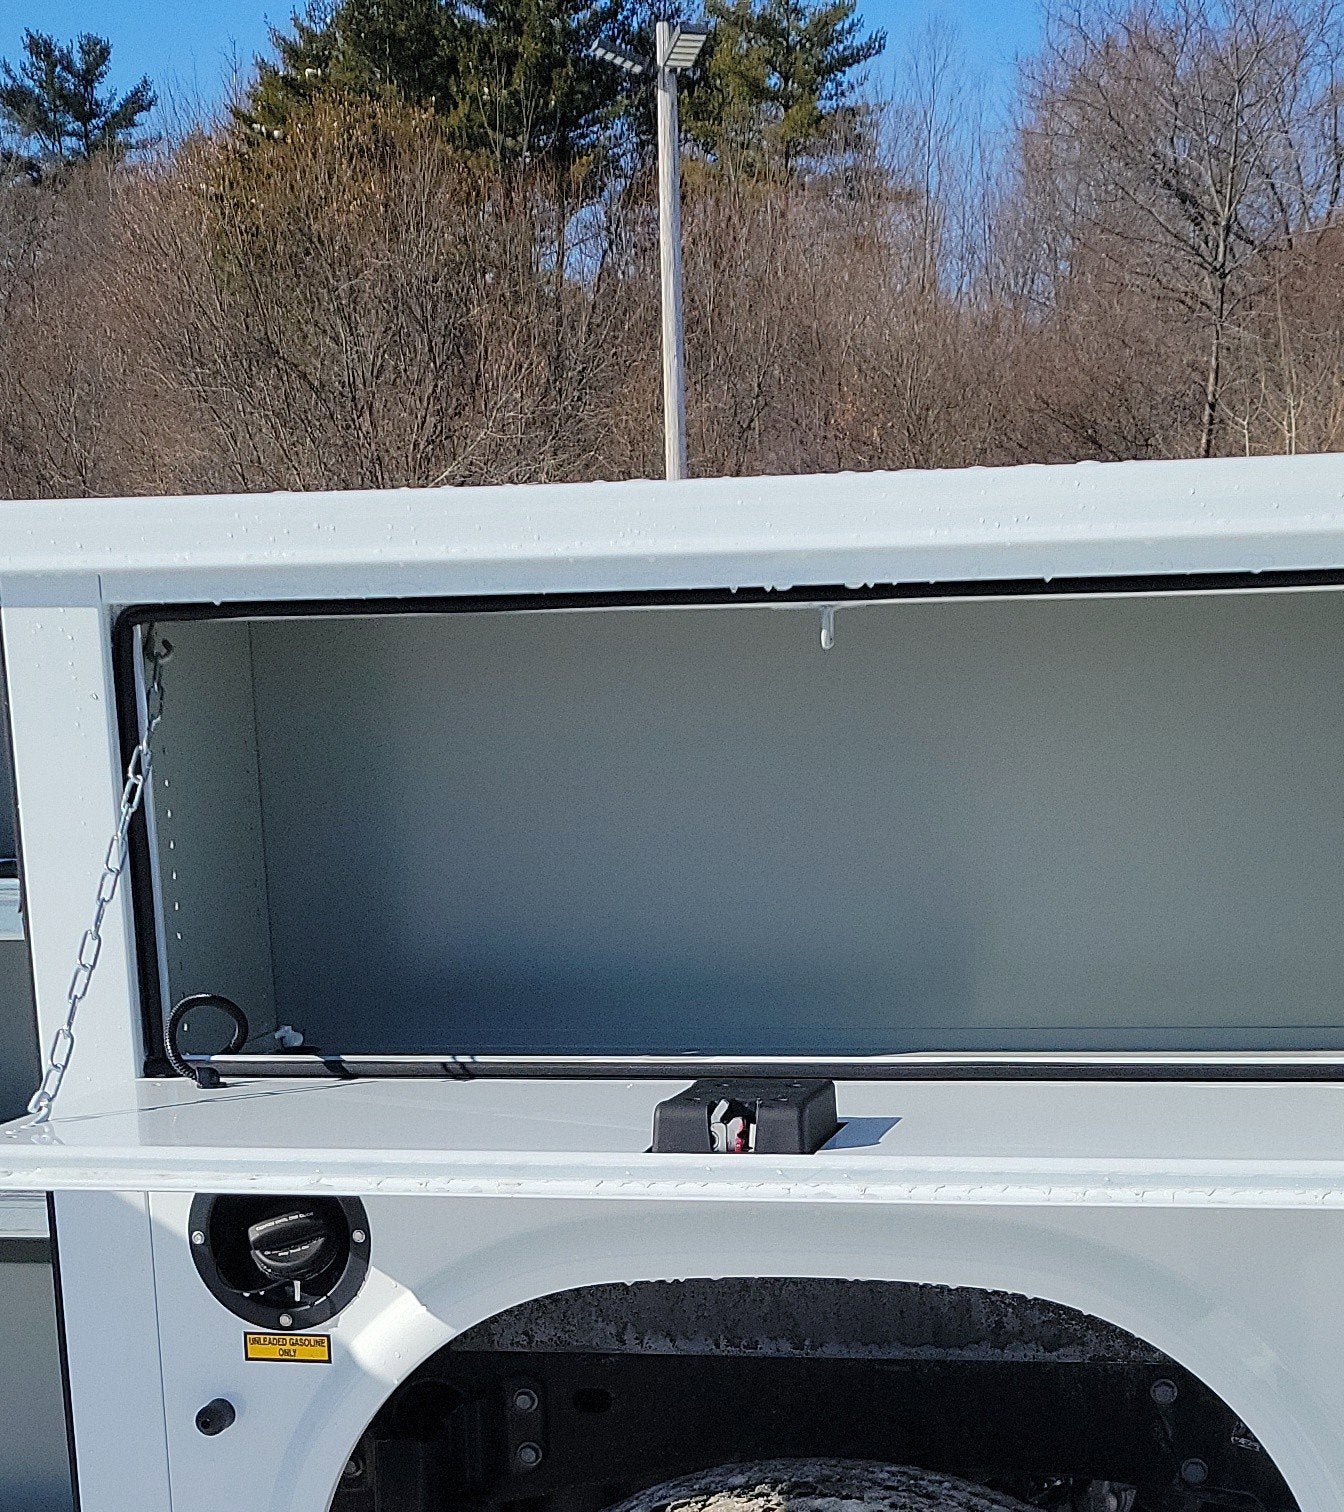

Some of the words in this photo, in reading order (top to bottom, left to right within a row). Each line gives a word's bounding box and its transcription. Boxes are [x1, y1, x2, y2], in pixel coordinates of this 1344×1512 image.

[248, 1336, 288, 1347] UNLEADED
[289, 1337, 326, 1348] GASOLINE
[278, 1348, 297, 1357] ONLY
